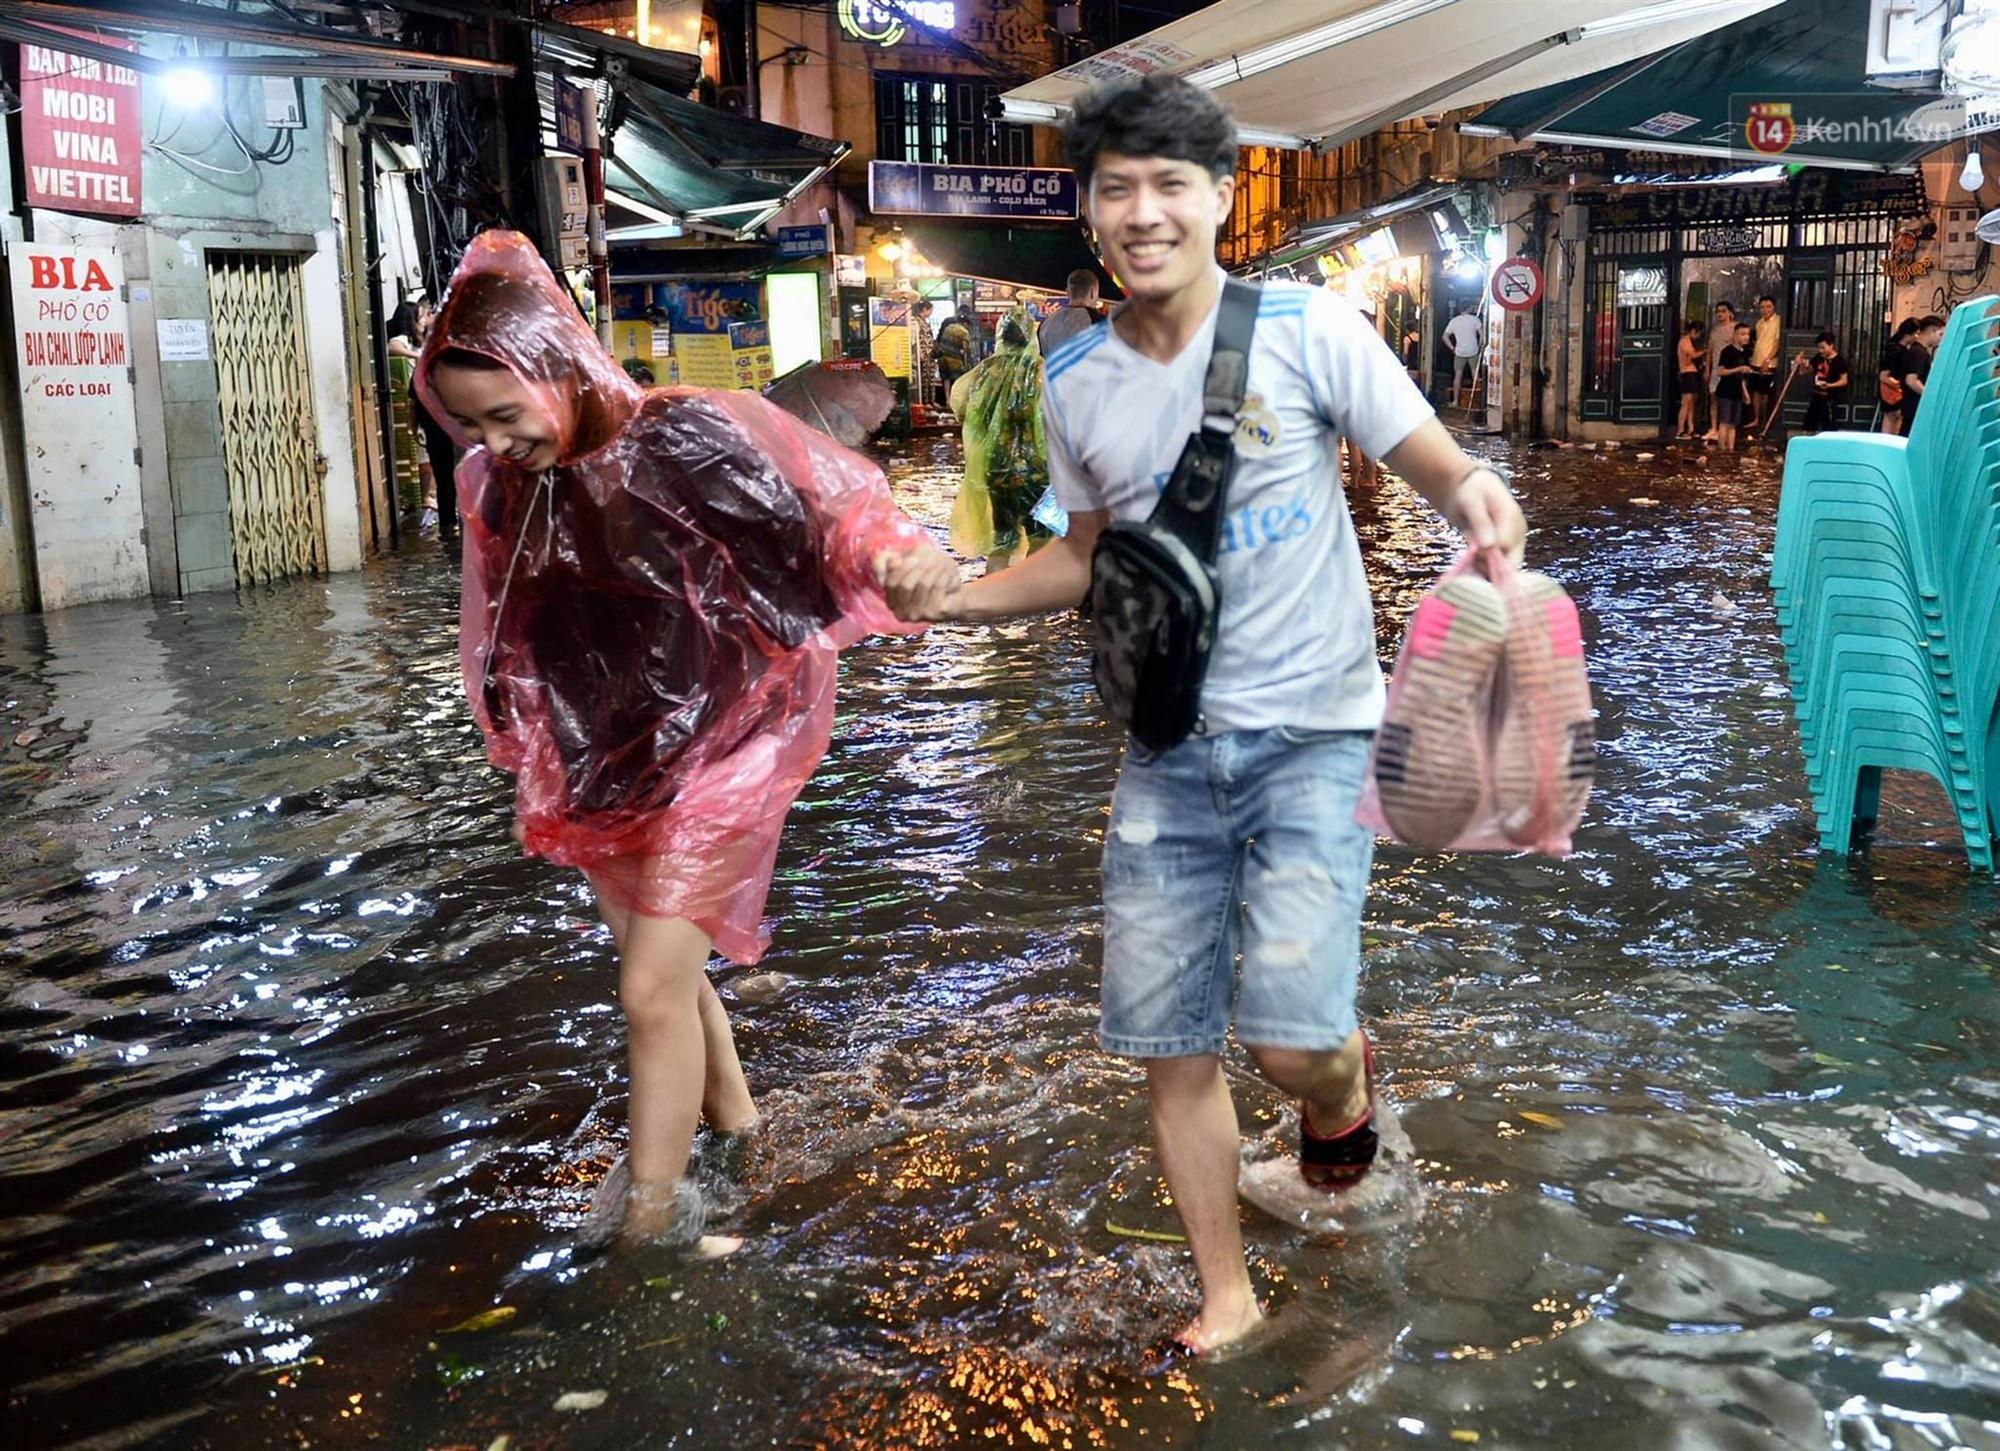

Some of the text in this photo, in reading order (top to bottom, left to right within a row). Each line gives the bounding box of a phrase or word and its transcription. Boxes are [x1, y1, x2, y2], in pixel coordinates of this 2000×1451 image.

[43, 87, 115, 125] MOBI
[53, 130, 118, 165] VINA
[31, 166, 134, 204] VIETTEL
[933, 172, 1062, 195] BIA PHỐ CỔ
[1699, 229, 1758, 247] STRONGBOW
[29, 255, 114, 292] BIA
[1880, 258, 1934, 285] Tiger
[25, 332, 46, 366] BIA
[45, 378, 111, 397] CÁC LOẠI
